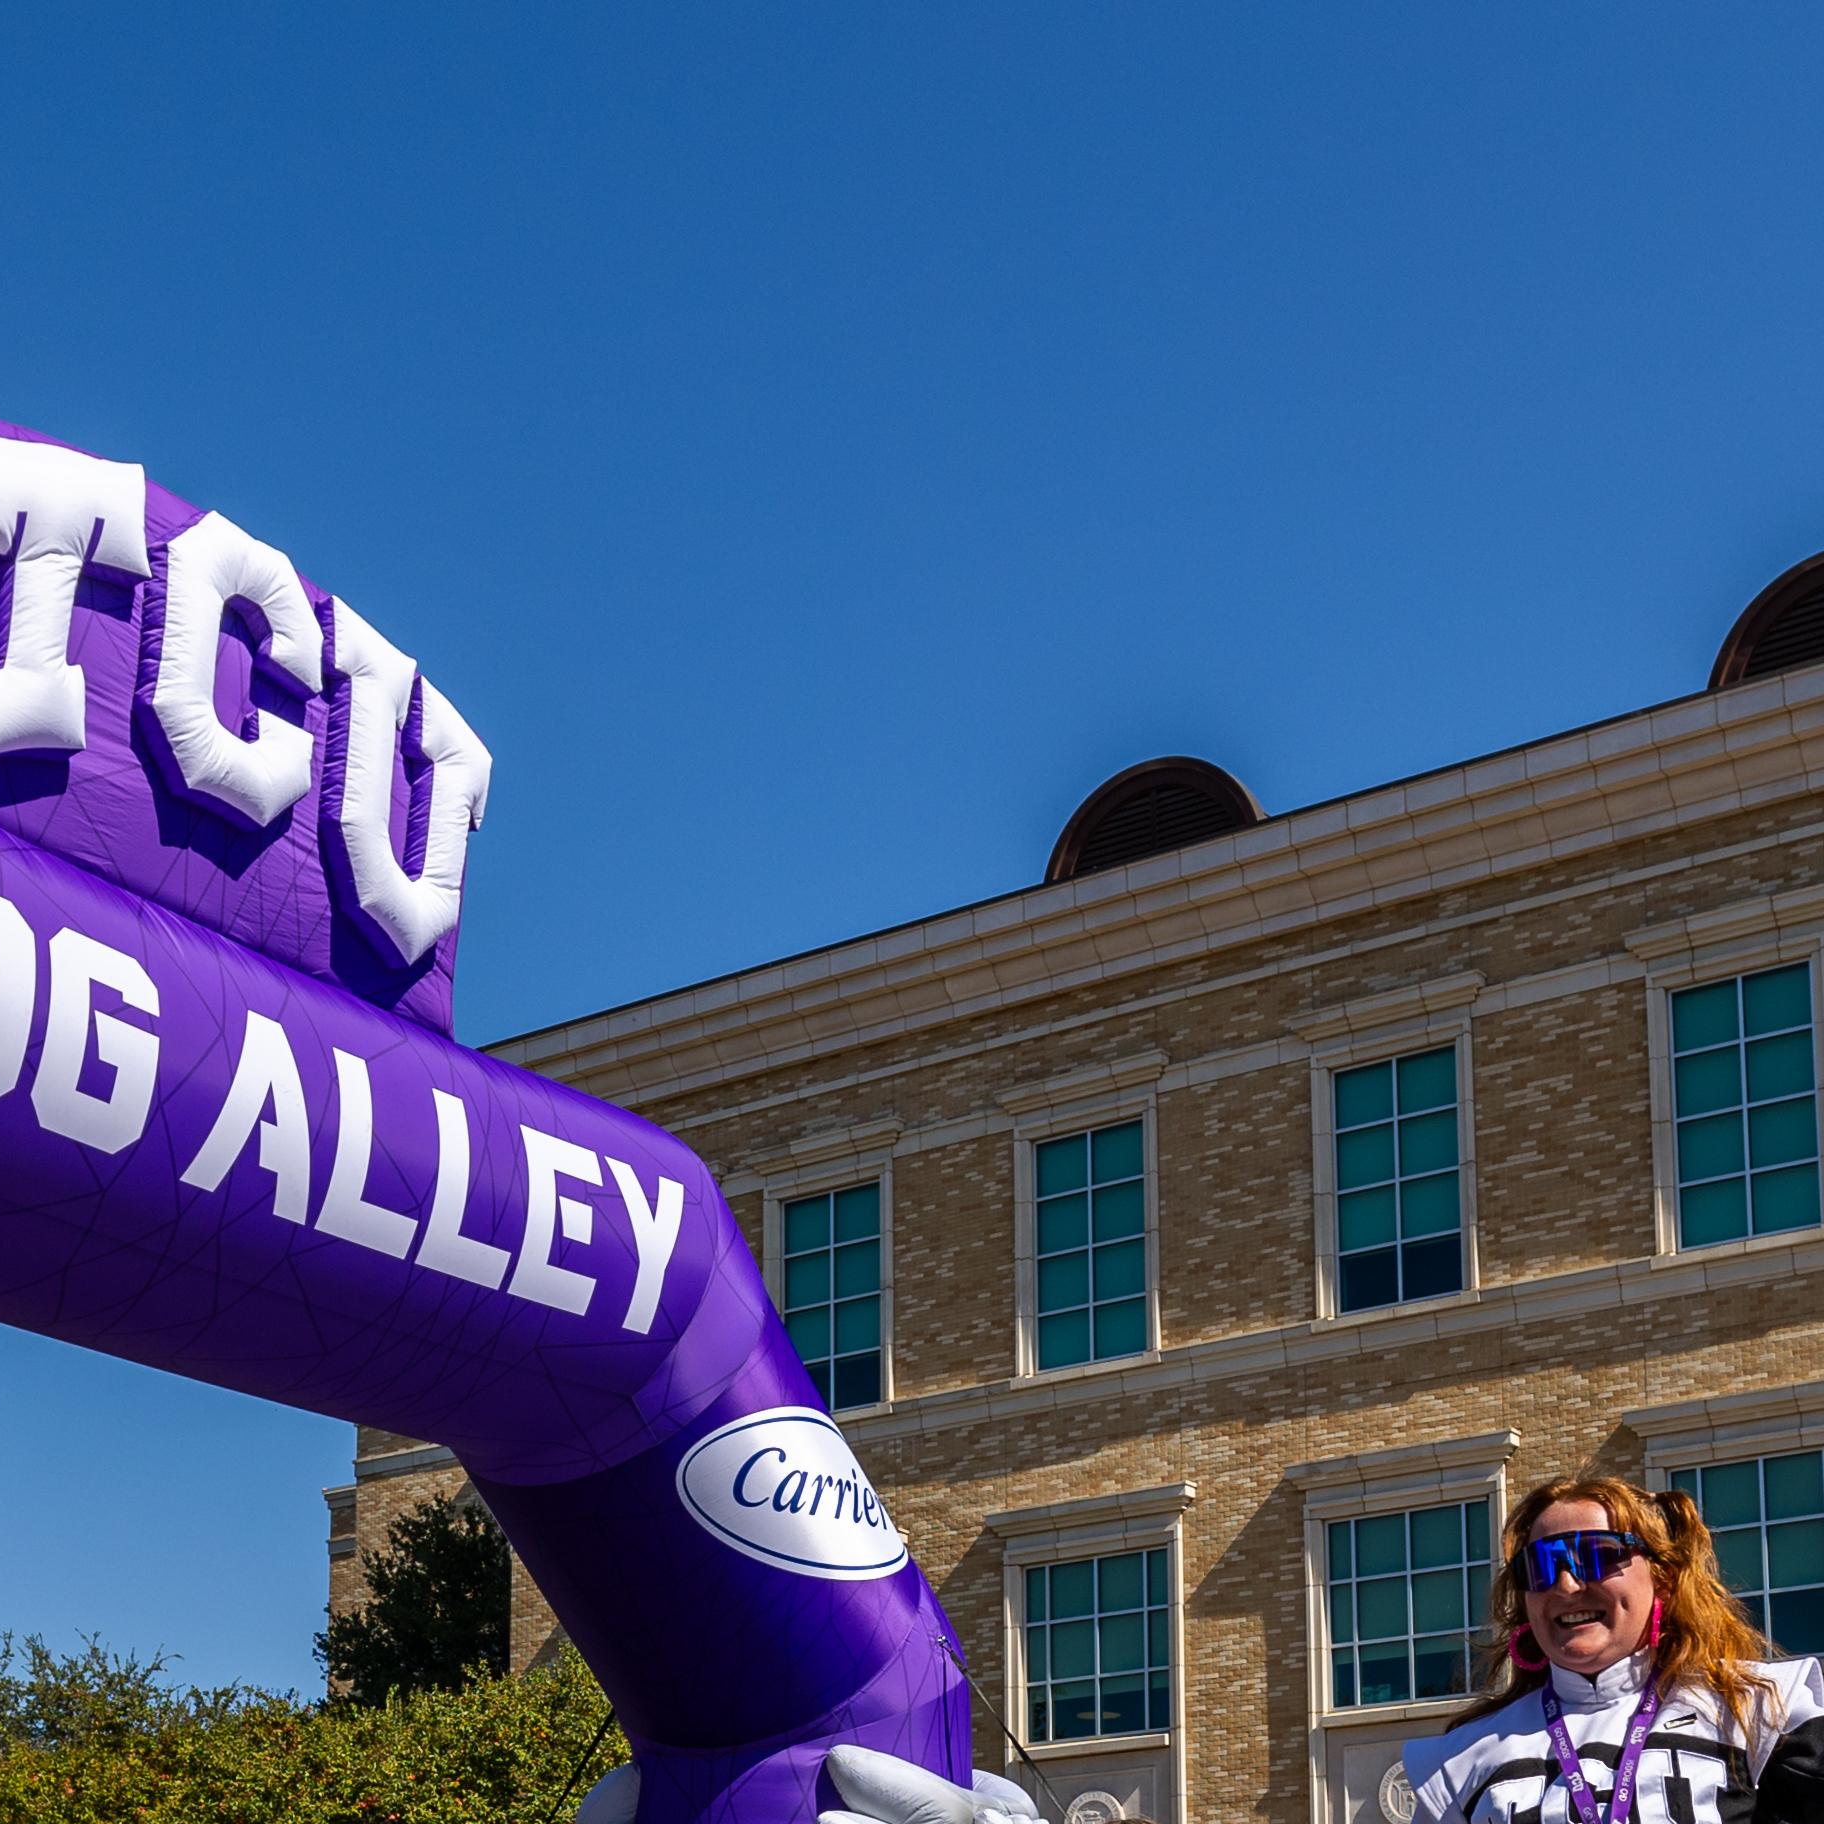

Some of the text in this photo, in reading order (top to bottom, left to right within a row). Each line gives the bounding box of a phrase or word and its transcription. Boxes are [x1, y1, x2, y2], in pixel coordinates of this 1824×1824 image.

[179, 1009, 685, 1335] ALLEY
[1554, 1727, 1563, 1739] GO
[1630, 1726, 1646, 1745] TCU
[1568, 1771, 1585, 1793] TCU
[1618, 1759, 1634, 1802] GO FROGS!
[1583, 1806, 1594, 1820] GO
